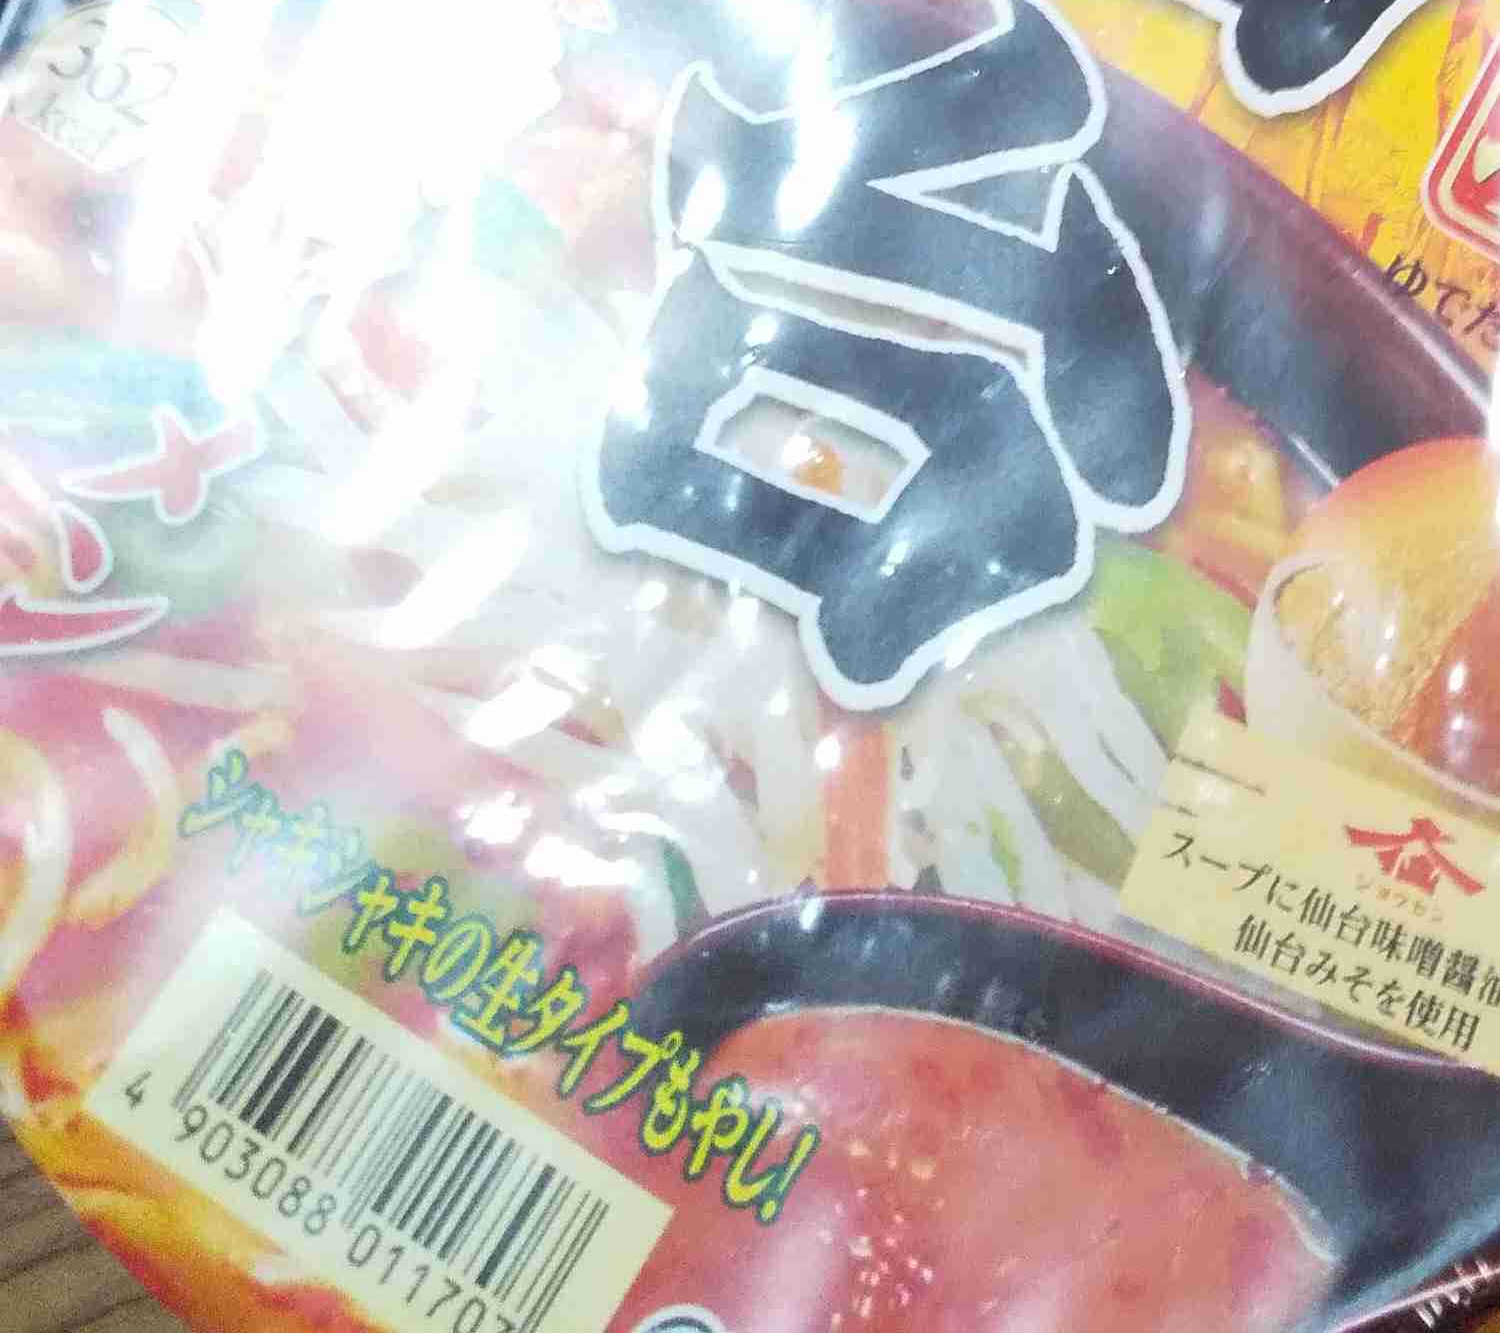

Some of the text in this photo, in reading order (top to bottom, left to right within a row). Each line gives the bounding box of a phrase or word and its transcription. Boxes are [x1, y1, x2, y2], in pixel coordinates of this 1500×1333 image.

[1232, 913, 1481, 1054] 仙台みそを使用
[173, 1102, 338, 1237] 903088
